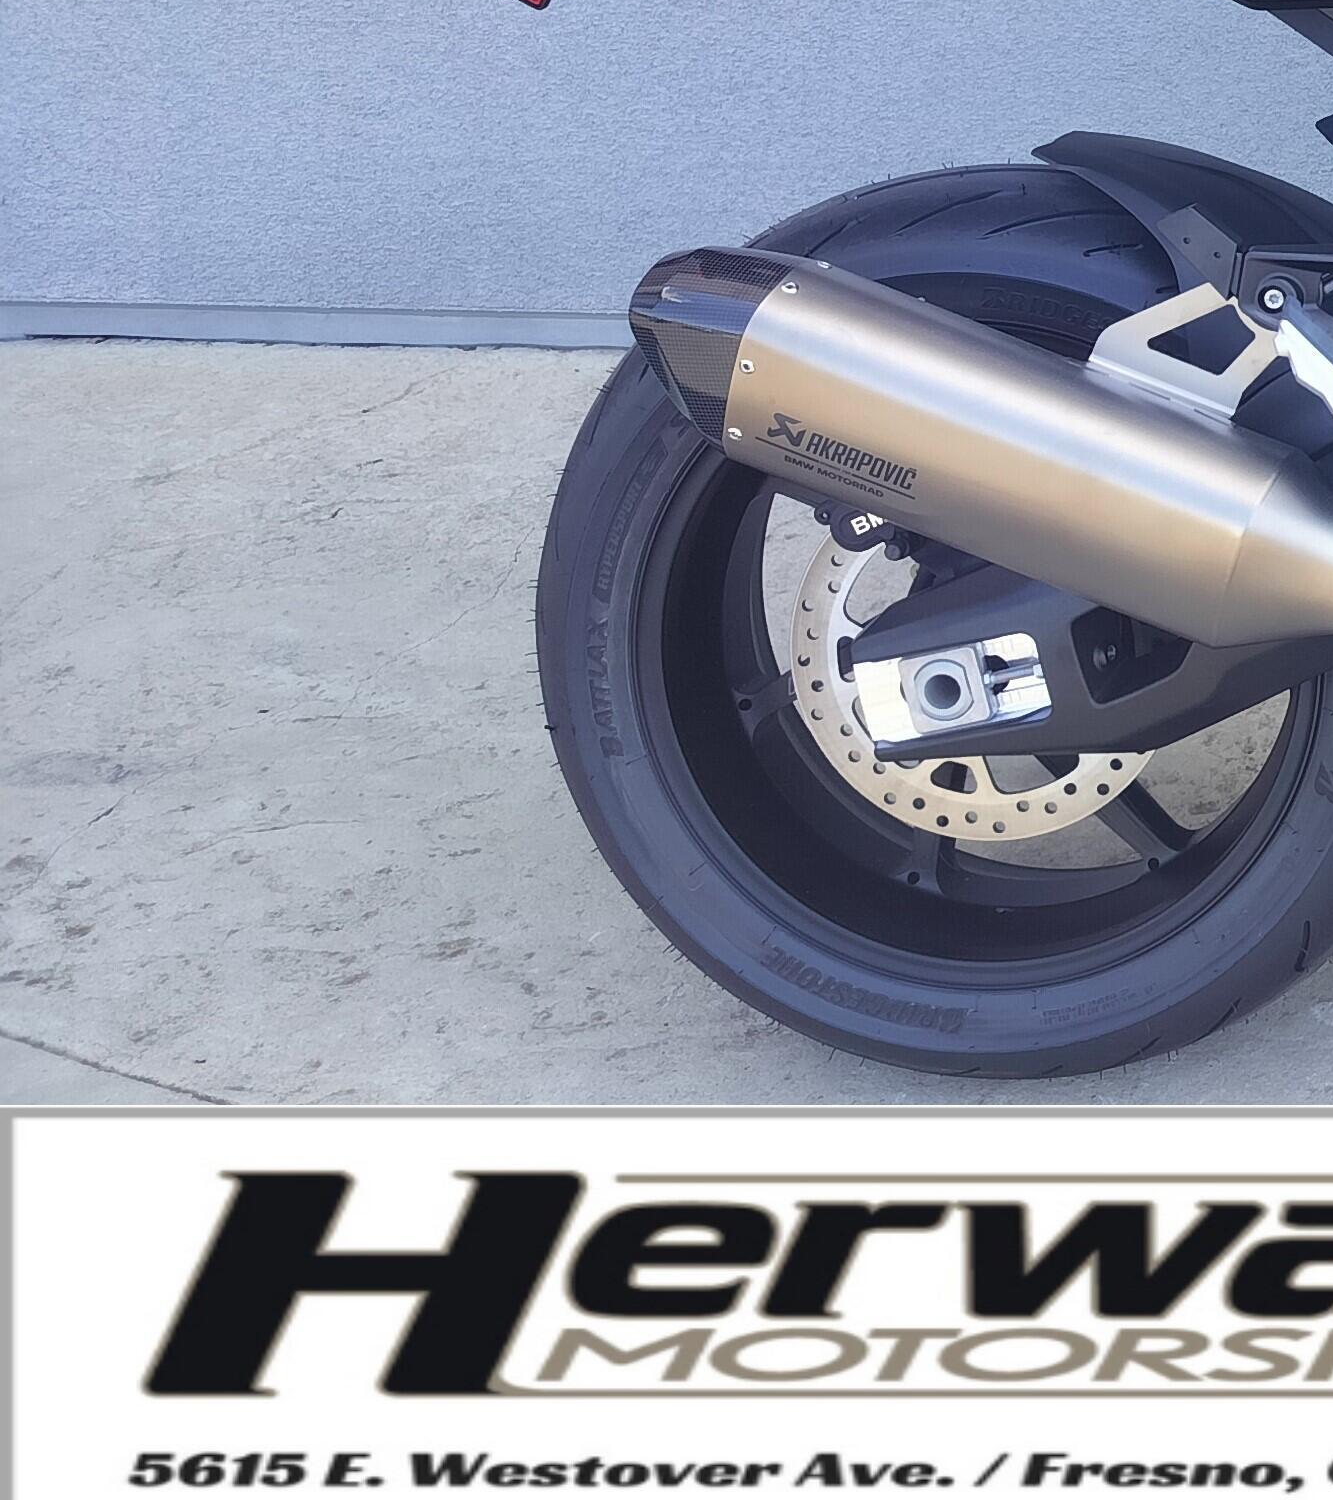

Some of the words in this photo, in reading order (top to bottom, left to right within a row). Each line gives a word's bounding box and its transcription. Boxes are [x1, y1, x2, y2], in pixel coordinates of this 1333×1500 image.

[783, 454, 814, 472] BMW
[817, 467, 884, 498] MOTORRAD
[806, 432, 917, 491] AKRAPOVIČ
